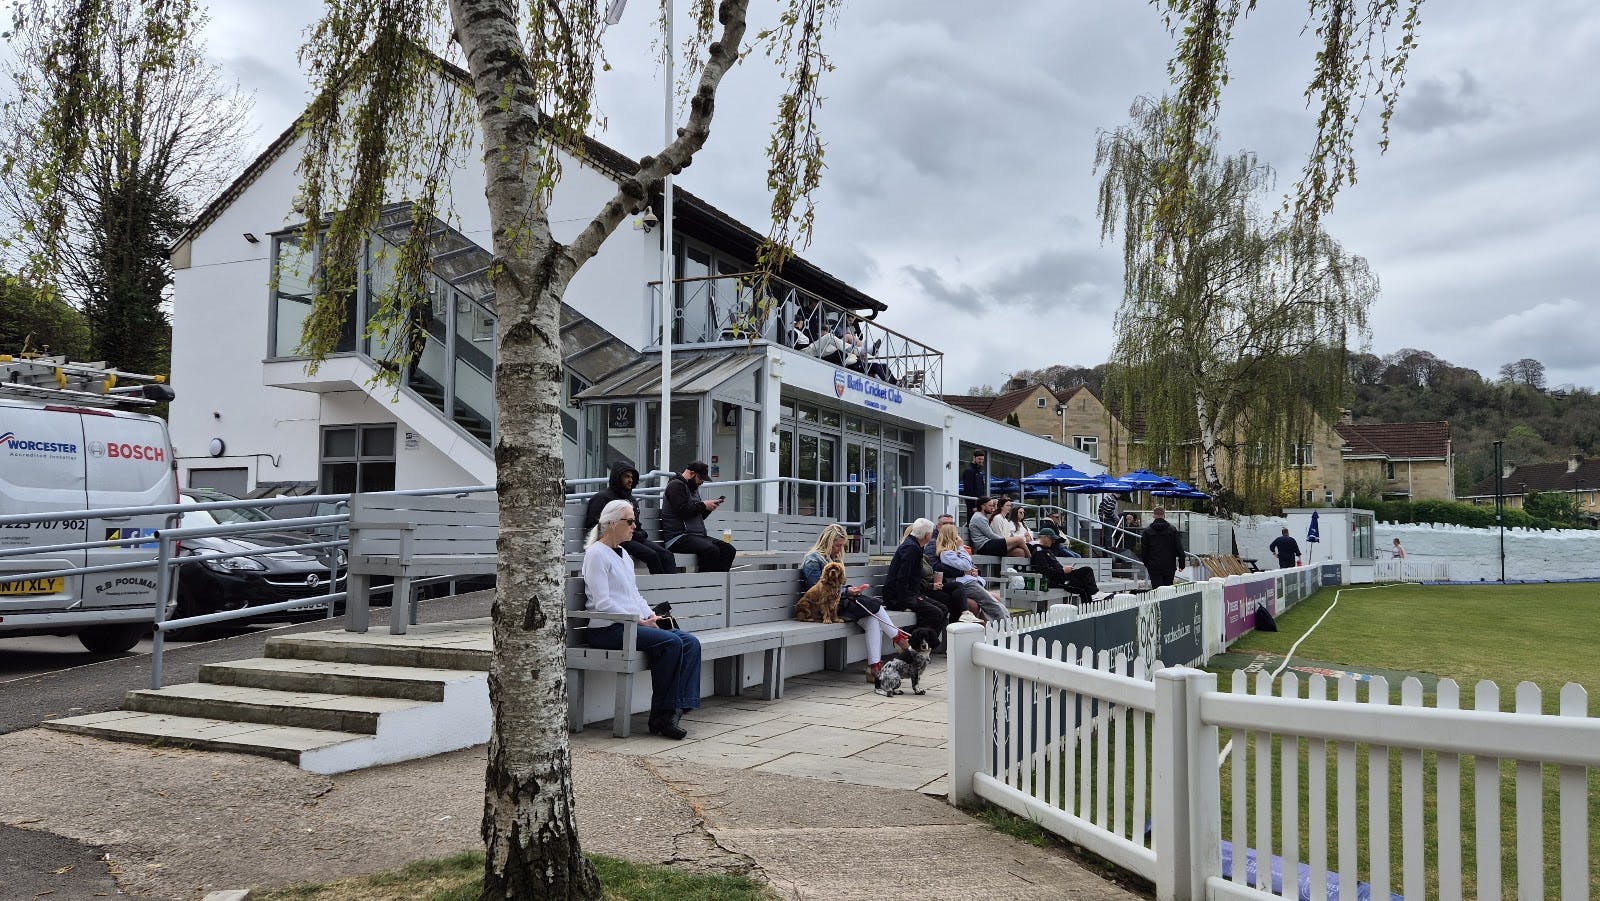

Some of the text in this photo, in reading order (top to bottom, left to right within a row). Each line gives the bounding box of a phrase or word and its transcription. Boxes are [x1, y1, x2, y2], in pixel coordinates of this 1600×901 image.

[847, 374, 903, 404] Bath Cricket Club
[616, 407, 628, 421] 32
[8, 439, 77, 453] WORCESTER
[107, 442, 165, 462] BOSCH
[9, 451, 77, 461] Accredited Installer
[61, 519, 86, 530] 902
